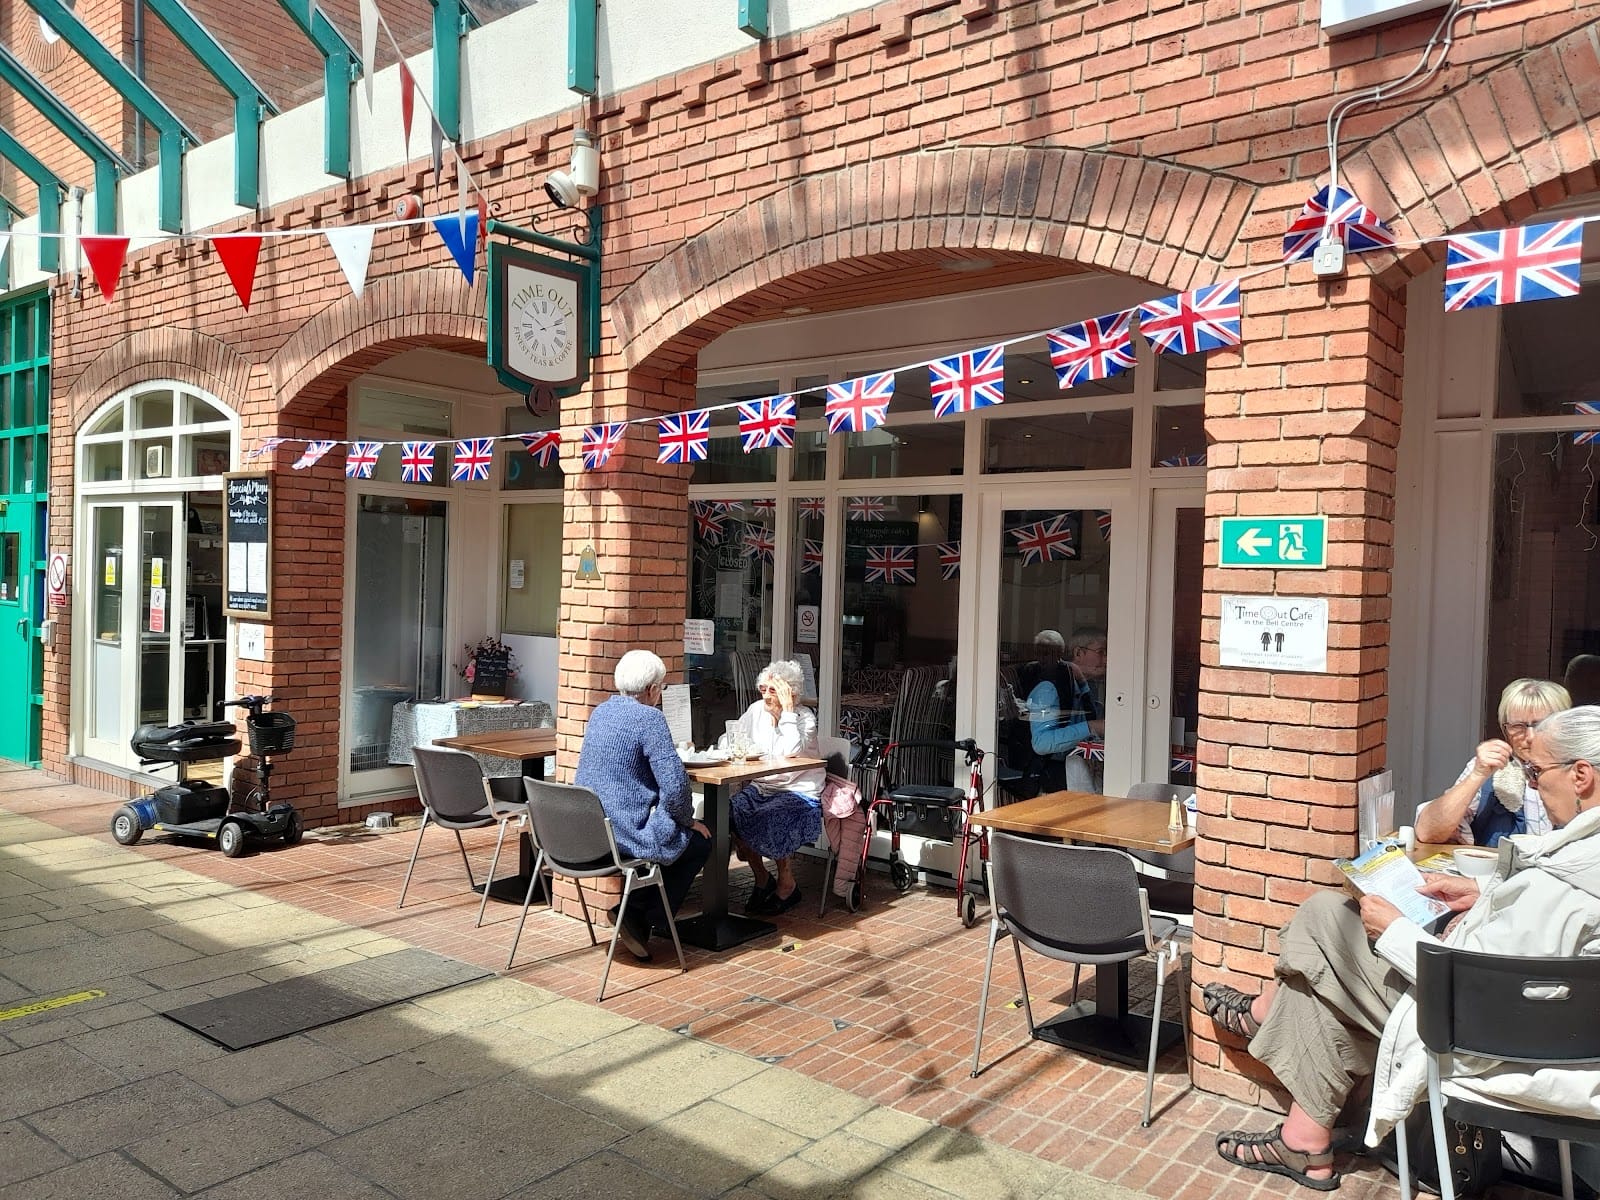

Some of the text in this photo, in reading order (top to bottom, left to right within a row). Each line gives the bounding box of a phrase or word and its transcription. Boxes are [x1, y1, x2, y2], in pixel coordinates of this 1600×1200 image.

[512, 284, 574, 318] TIME OUT
[513, 326, 573, 367] FINEST TEAS & COFFEE
[720, 557, 748, 569] CLOSED
[1235, 605, 1313, 621] Time Out Cafe
